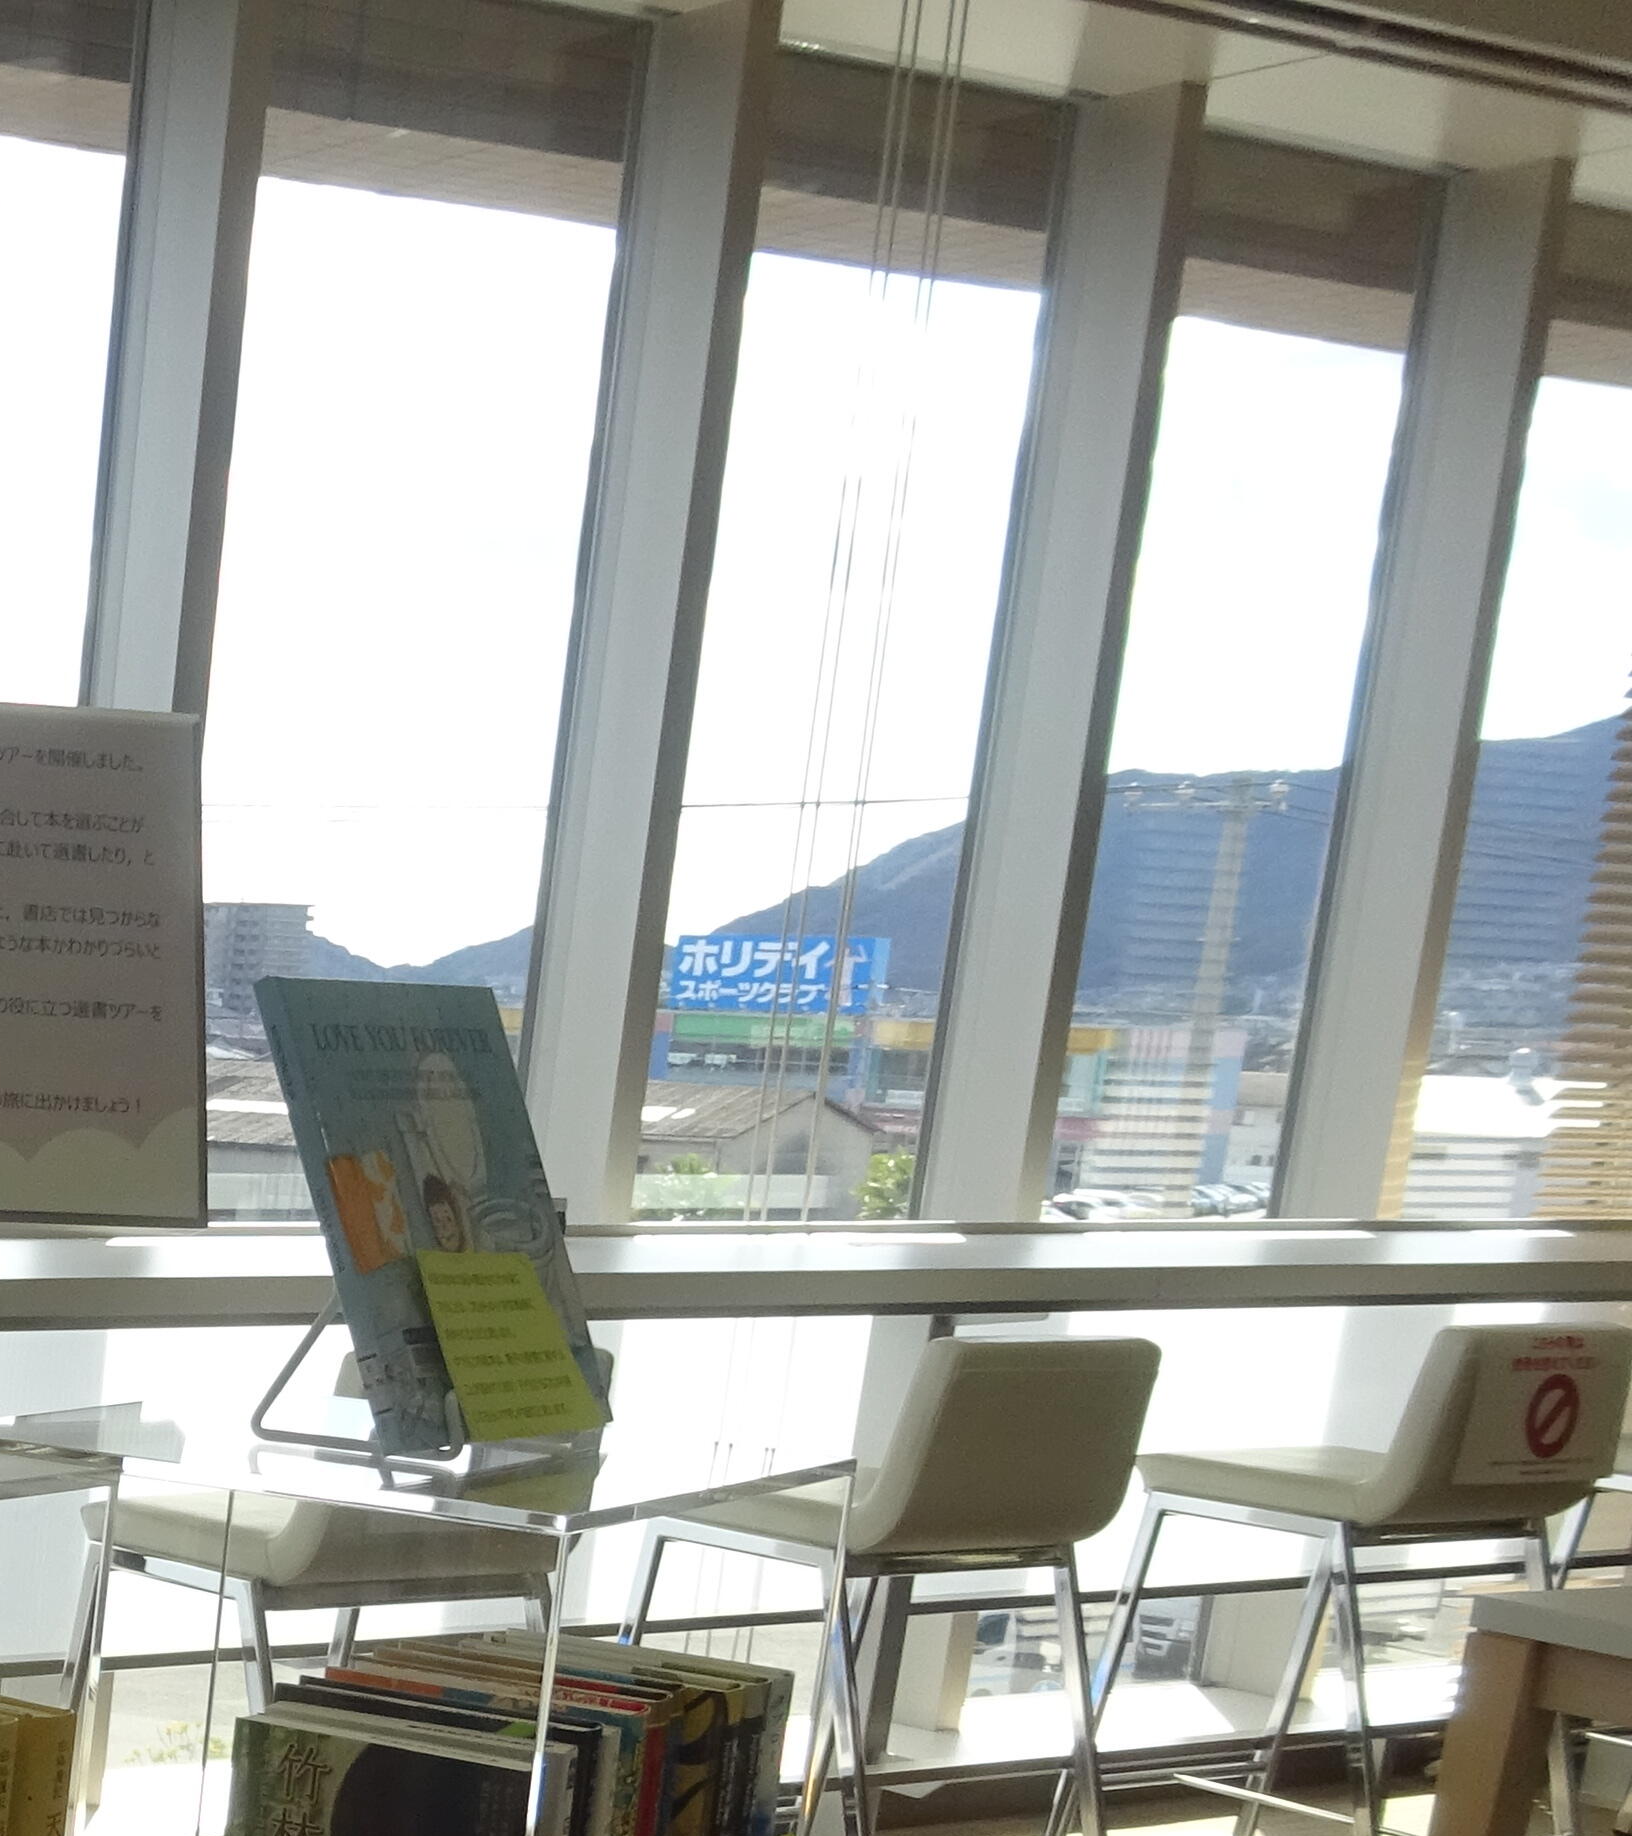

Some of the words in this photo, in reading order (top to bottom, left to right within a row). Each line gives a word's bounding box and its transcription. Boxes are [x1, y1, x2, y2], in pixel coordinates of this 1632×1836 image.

[678, 939, 831, 978] ホリデイ
[674, 980, 826, 1004] スポーツクラブ
